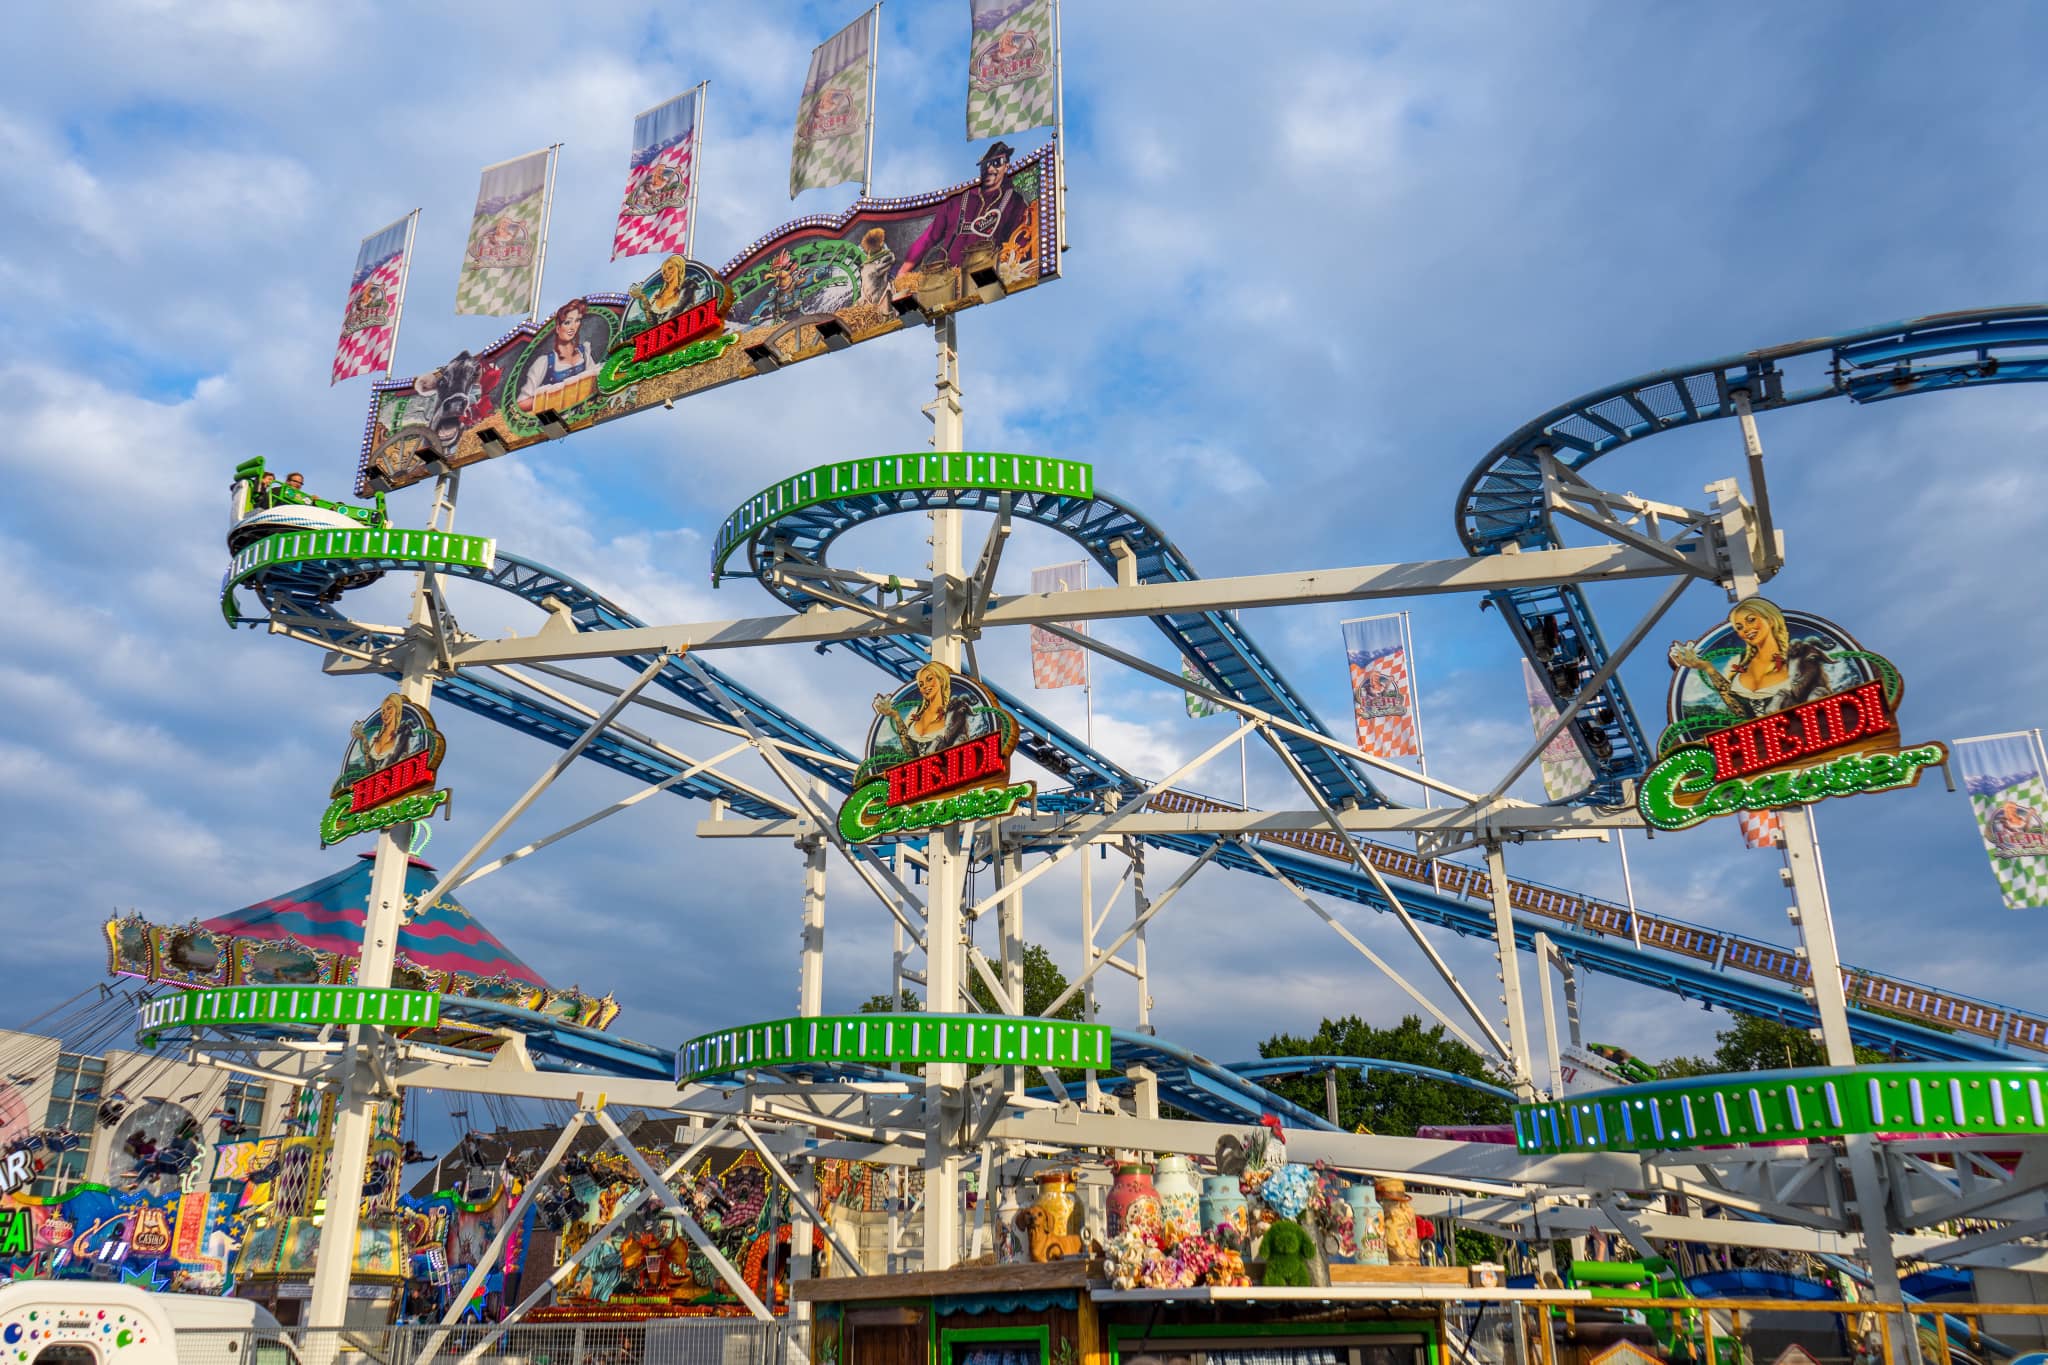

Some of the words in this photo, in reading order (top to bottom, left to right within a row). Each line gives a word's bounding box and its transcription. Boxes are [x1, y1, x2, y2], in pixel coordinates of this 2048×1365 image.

[632, 299, 721, 363] HEIDI
[1707, 681, 1891, 782] HEIDI
[350, 750, 433, 813] HEIDI
[886, 733, 1006, 808] HEIDI
[1640, 746, 1944, 830] Coaster
[839, 780, 1034, 844] Coaster
[138, 1233, 165, 1245] CASINO
